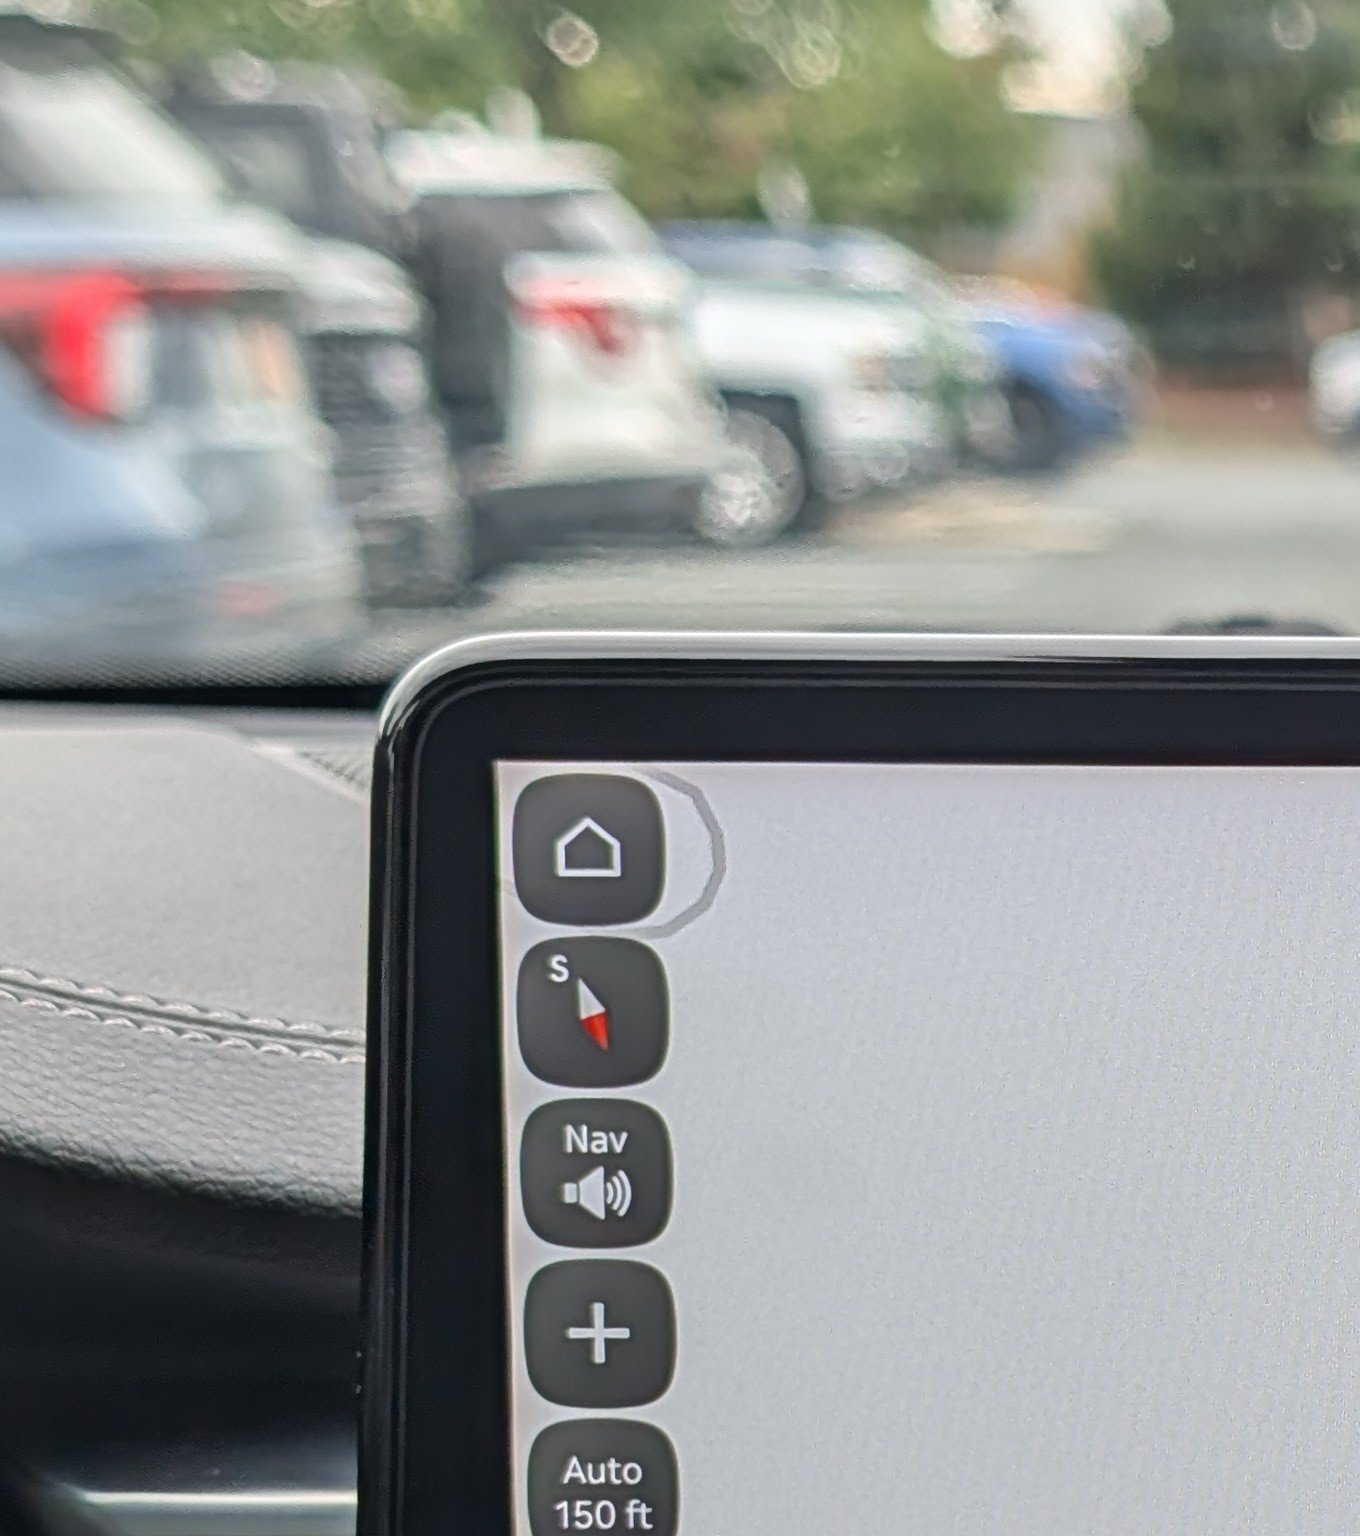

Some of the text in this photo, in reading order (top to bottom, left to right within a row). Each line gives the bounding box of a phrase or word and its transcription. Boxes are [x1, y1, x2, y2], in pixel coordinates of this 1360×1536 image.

[546, 954, 569, 983] S
[563, 1124, 628, 1154] Nav
[562, 1455, 643, 1485] Auto
[555, 1500, 653, 1530] 150 ft
